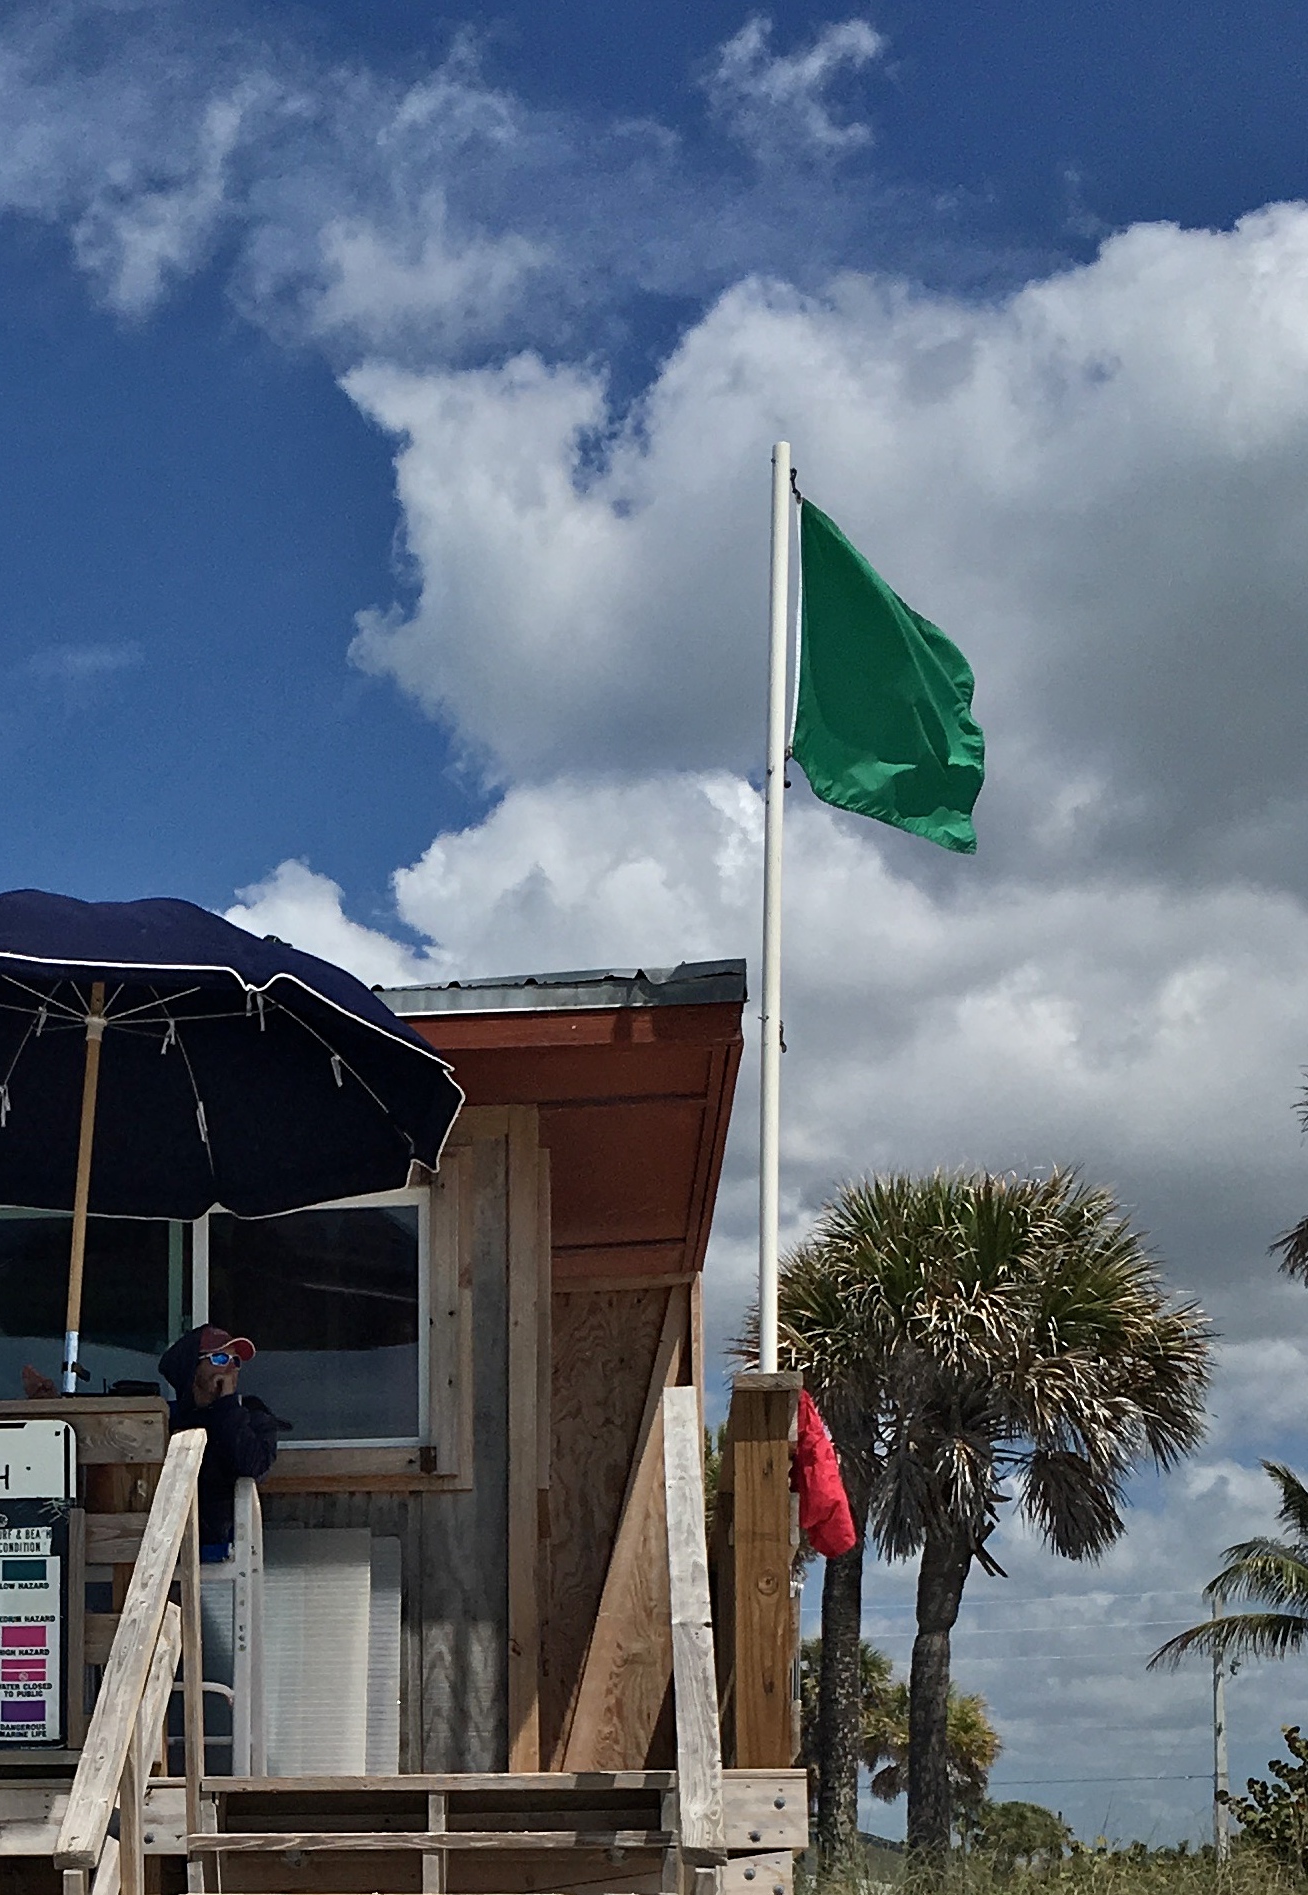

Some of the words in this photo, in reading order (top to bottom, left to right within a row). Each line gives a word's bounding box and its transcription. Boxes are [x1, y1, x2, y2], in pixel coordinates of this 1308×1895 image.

[16, 1529, 22, 1540] &
[25, 1528, 52, 1540] BEAH
[18, 1582, 50, 1590] HAZARD
[24, 1615, 56, 1623] HAZARD
[18, 1648, 50, 1656] HAZARD
[23, 1682, 52, 1690] CLOSED
